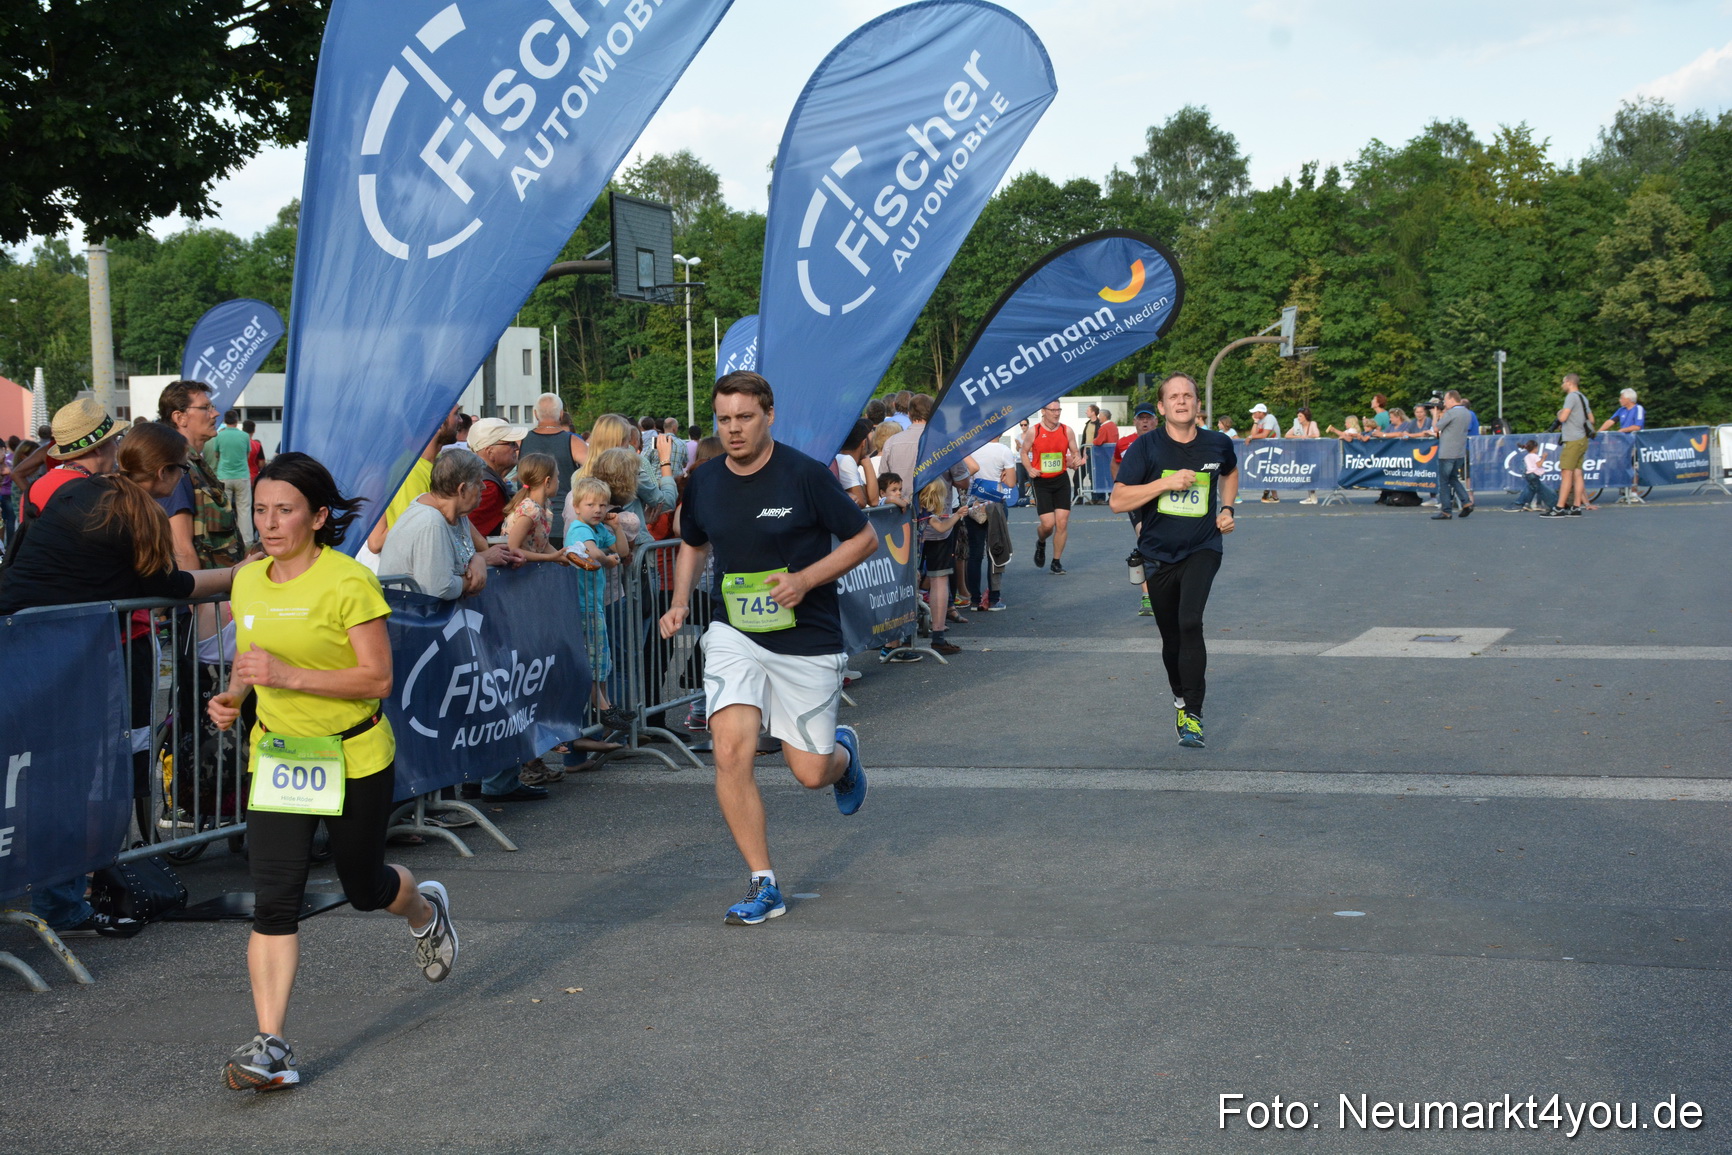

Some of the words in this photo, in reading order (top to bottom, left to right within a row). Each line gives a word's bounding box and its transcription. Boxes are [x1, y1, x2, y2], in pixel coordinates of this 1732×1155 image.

[419, 0, 609, 205] Fisc
[510, 0, 664, 202] AUTOMOB
[835, 49, 991, 278] Fischer
[893, 91, 1010, 273] AUTOMOBILE
[204, 315, 262, 390] Fischer
[1061, 336, 1099, 363] Druck
[1100, 323, 1125, 341] und
[1123, 296, 1169, 329] Medien
[225, 329, 269, 389] AUTOMOBILE
[959, 306, 1116, 406] Frischmann
[1043, 460, 1061, 468] 1380
[1256, 460, 1317, 475] Fischer
[1345, 454, 1413, 470] Frischmann
[1640, 446, 1696, 463] Frischmann
[1170, 490, 1200, 504] 676
[836, 556, 896, 595] schmann
[868, 589, 887, 610] Druck
[886, 586, 899, 605] und
[736, 596, 779, 616] 745
[438, 650, 556, 718] Fischer
[272, 763, 327, 792] 600
